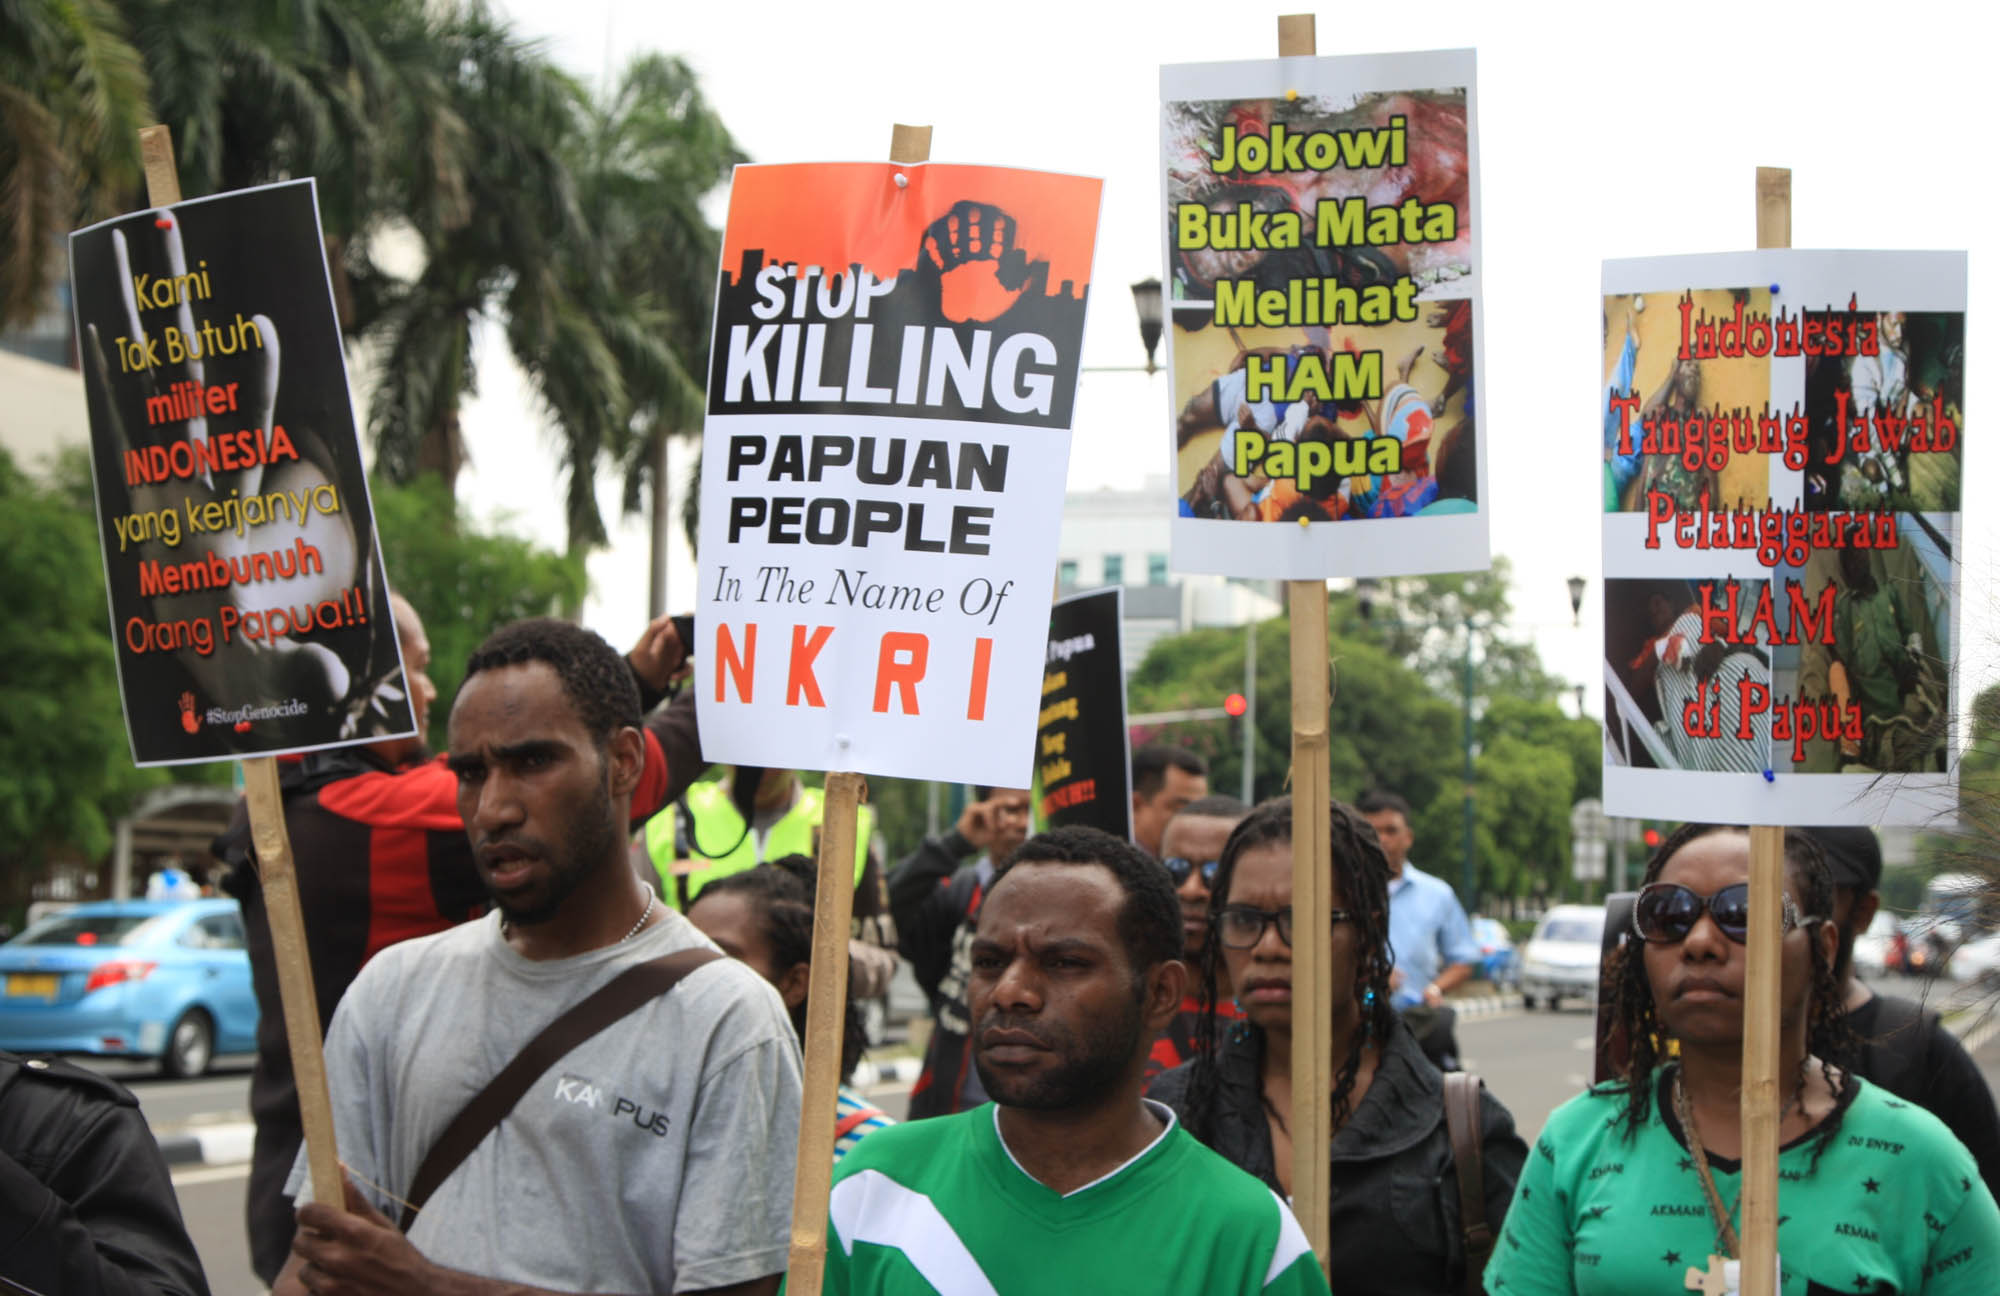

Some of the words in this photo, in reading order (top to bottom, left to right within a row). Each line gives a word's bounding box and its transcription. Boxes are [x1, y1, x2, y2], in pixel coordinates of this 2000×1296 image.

[1211, 116, 1407, 174] Jokowi
[1178, 201, 1302, 251] Buka
[1315, 197, 1457, 248] Mata
[134, 261, 212, 312] Kami
[750, 263, 898, 321] STOP
[1213, 275, 1419, 328] Melihat
[115, 330, 162, 374] Tak
[163, 313, 264, 366] Butuh
[1677, 290, 1881, 361] Indonesia
[724, 323, 1059, 417] KILLING
[1244, 351, 1383, 403] HAM
[146, 379, 239, 426] militer
[1609, 387, 1809, 472] Tanggung
[1824, 383, 1958, 467] Jawab
[123, 425, 299, 486] INDONESIA
[726, 434, 1010, 493] PAPUAN
[1233, 429, 1402, 492] Papua
[113, 507, 182, 553] yang
[184, 482, 341, 538] kerjanya
[727, 496, 995, 556] PEOPLE
[1645, 485, 1899, 567] Pelanggaran
[138, 537, 323, 597] Membunuh
[712, 566, 742, 603] In
[756, 566, 815, 605] The
[825, 568, 945, 614] Name
[959, 577, 1015, 626] Of
[126, 614, 215, 656] Orang
[221, 586, 368, 645] Papua!!
[1698, 573, 1838, 647] HAM
[205, 698, 309, 724] #StopGenocide
[1682, 672, 1723, 740] di
[1736, 668, 1866, 762] Papua
